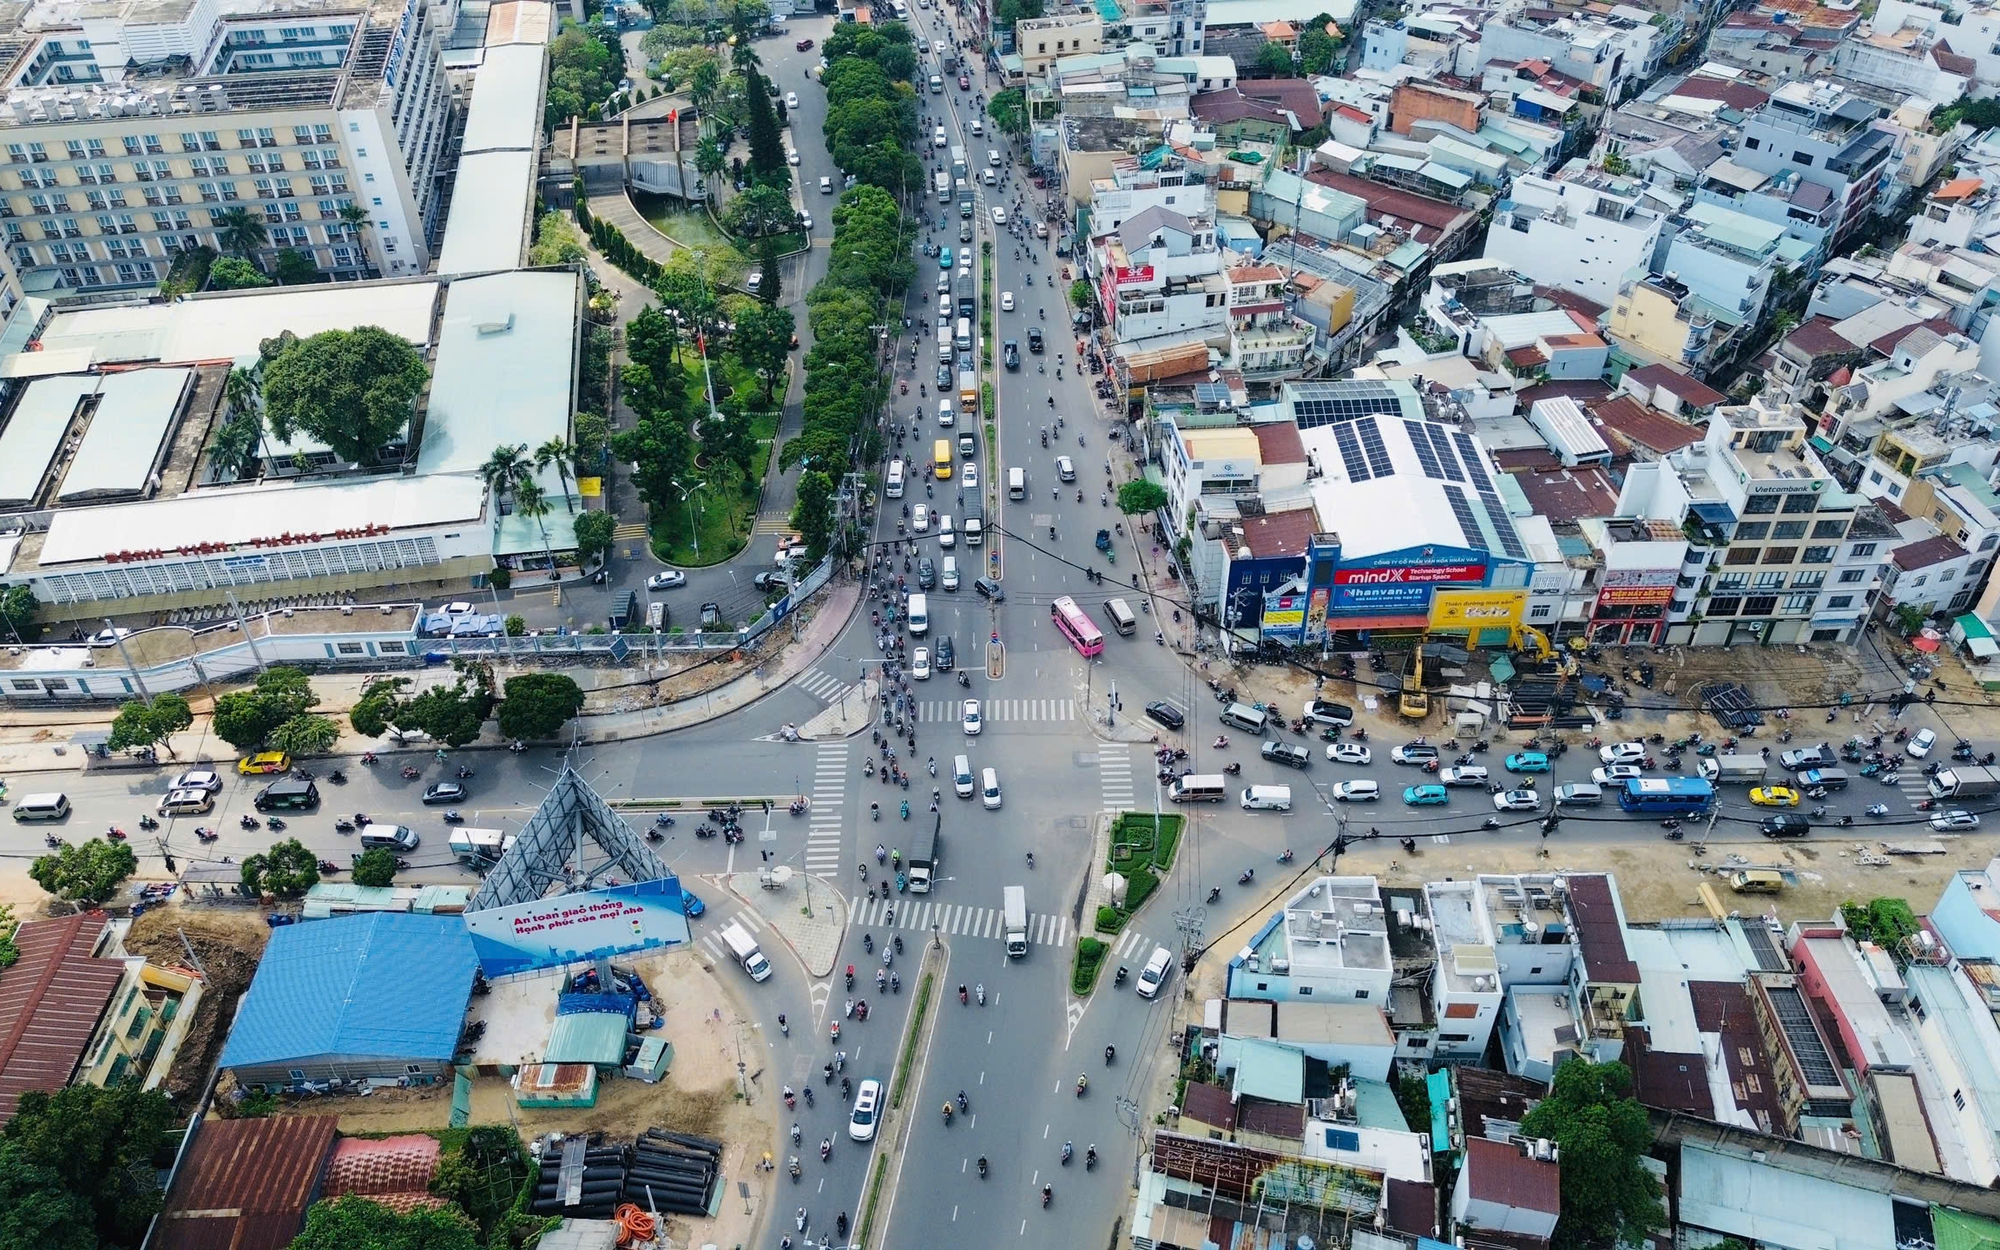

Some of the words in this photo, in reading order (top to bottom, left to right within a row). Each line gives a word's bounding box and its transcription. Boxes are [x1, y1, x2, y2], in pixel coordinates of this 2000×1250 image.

[1754, 485, 1809, 493] Vietcombank
[1348, 568, 1405, 584] mindX
[1344, 588, 1423, 597] Nhanvan.vn
[514, 917, 531, 926] An
[533, 911, 560, 922] toàn
[562, 908, 587, 919] giao
[588, 901, 623, 912] thông
[515, 924, 545, 934] Hạnh
[548, 918, 575, 931] phúc
[577, 914, 597, 924] của
[599, 909, 620, 920] mọi
[623, 906, 644, 915] nhà
